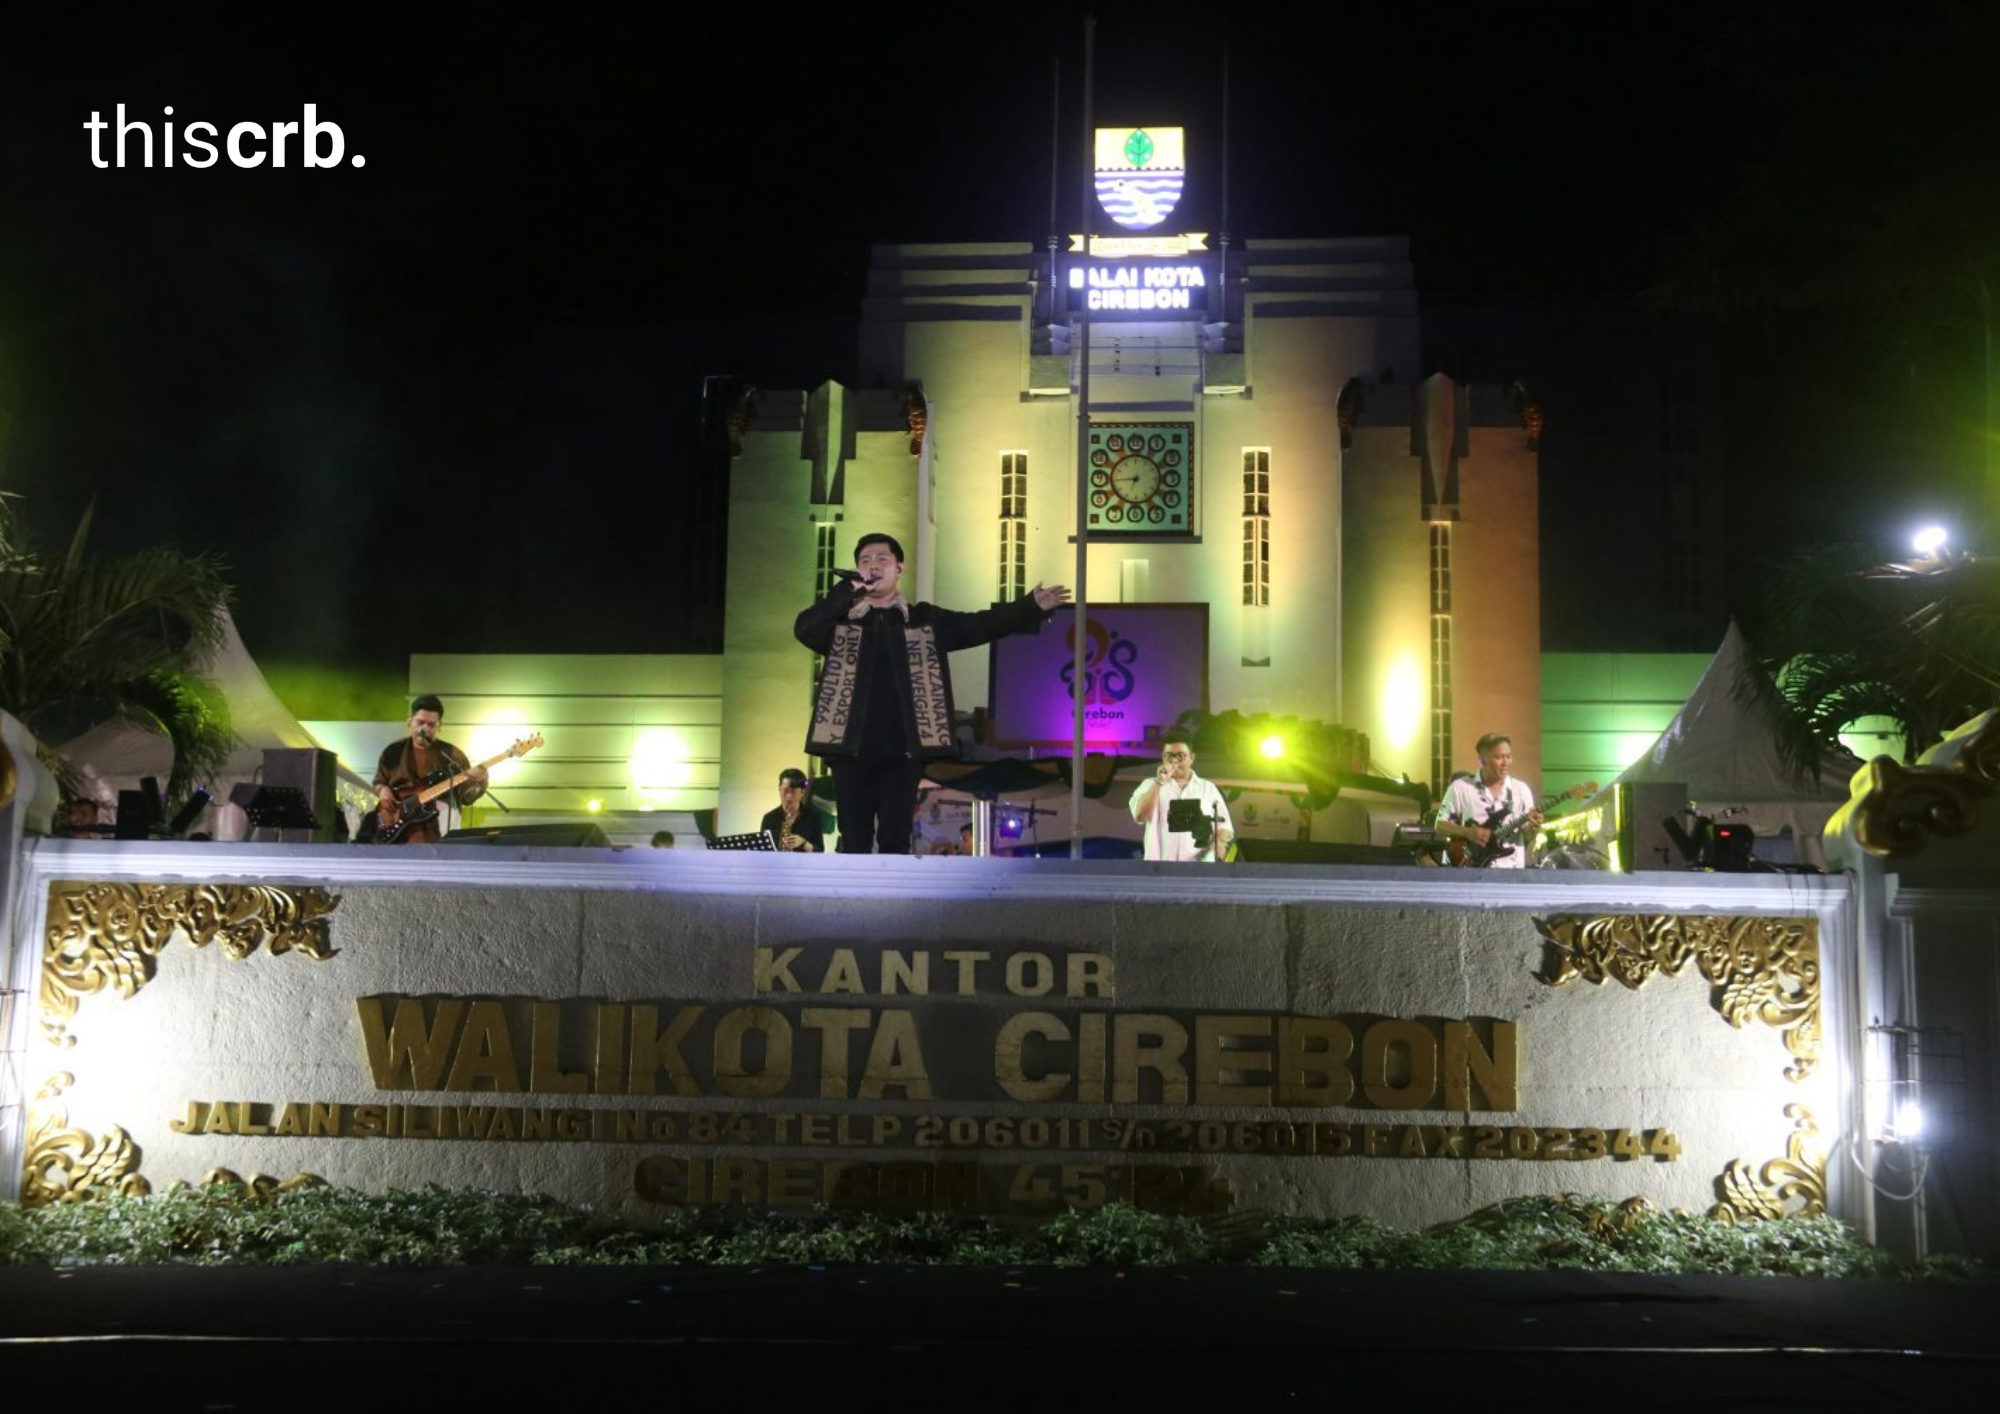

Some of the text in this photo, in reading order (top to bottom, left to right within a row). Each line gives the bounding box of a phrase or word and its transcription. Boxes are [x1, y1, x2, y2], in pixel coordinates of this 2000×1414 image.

[1088, 288, 1190, 310] CIREBON
[1144, 266, 1206, 288] KOTA
[832, 670, 855, 727] EXPORT
[845, 625, 862, 666] ONLY
[907, 640, 923, 668] NET
[909, 670, 932, 728] WEIGHT
[1072, 707, 1125, 719] rebon
[755, 947, 1114, 998] KANTOR
[357, 997, 1517, 1112] WALIKOTA CIREBON
[170, 1101, 341, 1137] JALAN
[352, 1105, 595, 1141] SILIWANGI
[617, 1111, 674, 1143] No
[687, 1111, 754, 1144] 84
[768, 1113, 903, 1147] TELP
[914, 1115, 1090, 1150] 206011
[1165, 1118, 1352, 1154] 206015
[1363, 1123, 1464, 1157] FAX
[1474, 1125, 1681, 1162] 202344
[634, 1155, 984, 1211] CIREBON
